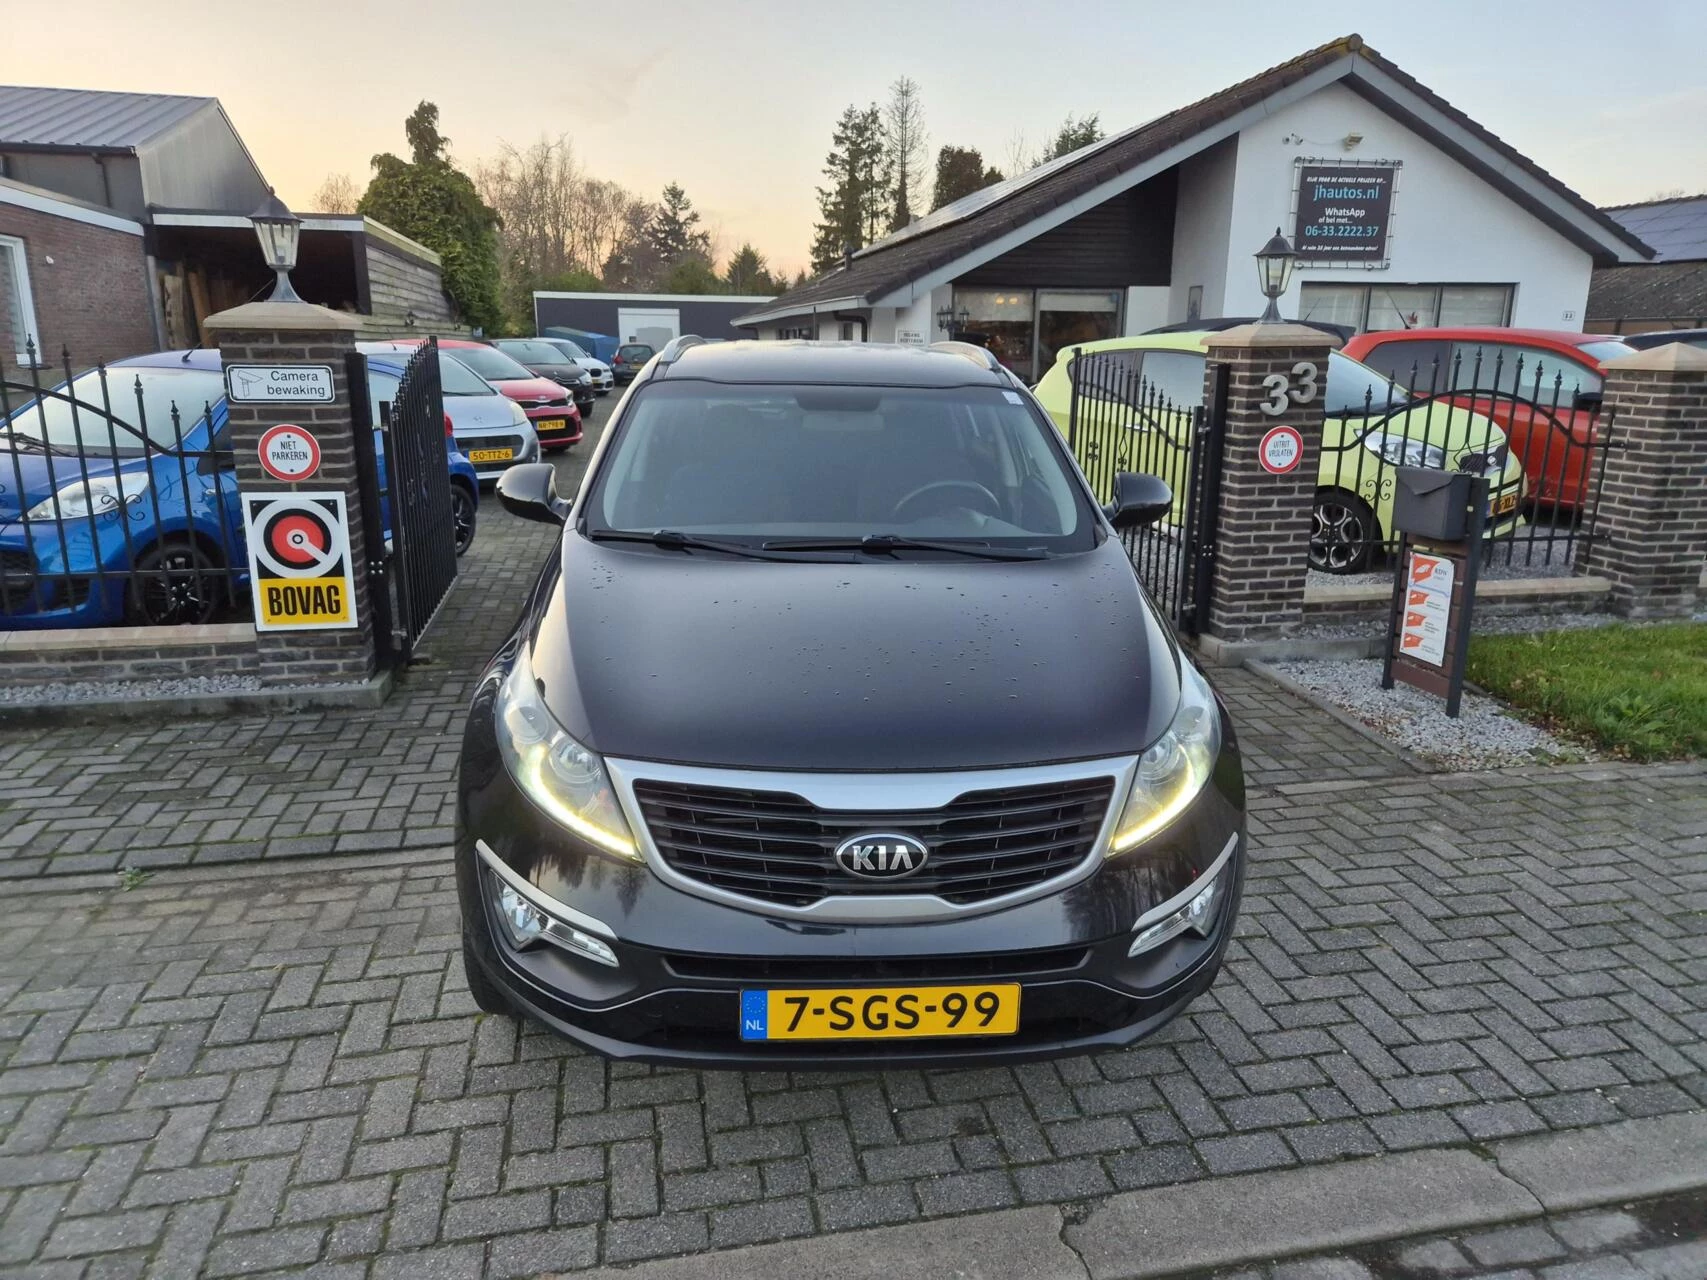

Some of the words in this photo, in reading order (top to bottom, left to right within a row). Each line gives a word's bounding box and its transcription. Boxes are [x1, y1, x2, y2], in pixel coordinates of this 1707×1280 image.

[1313, 184, 1380, 201] jhautos.nl
[1325, 207, 1366, 218] WhatsApp
[1305, 225, 1379, 236] 06-33.2222.37
[270, 370, 319, 382] Camera
[266, 384, 325, 398] bewaking
[1260, 361, 1318, 416] 33
[280, 441, 297, 450] NIET
[1273, 440, 1290, 449] UITRIT
[272, 451, 308, 461] PARKEREN
[473, 450, 510, 461] 50-TTZ-6
[1269, 449, 1294, 457] VRIJLATEN
[267, 585, 341, 616] BOVAG
[852, 845, 914, 870] KIA
[745, 1019, 764, 1031] NL
[784, 991, 1000, 1032] 7-SGS-99
